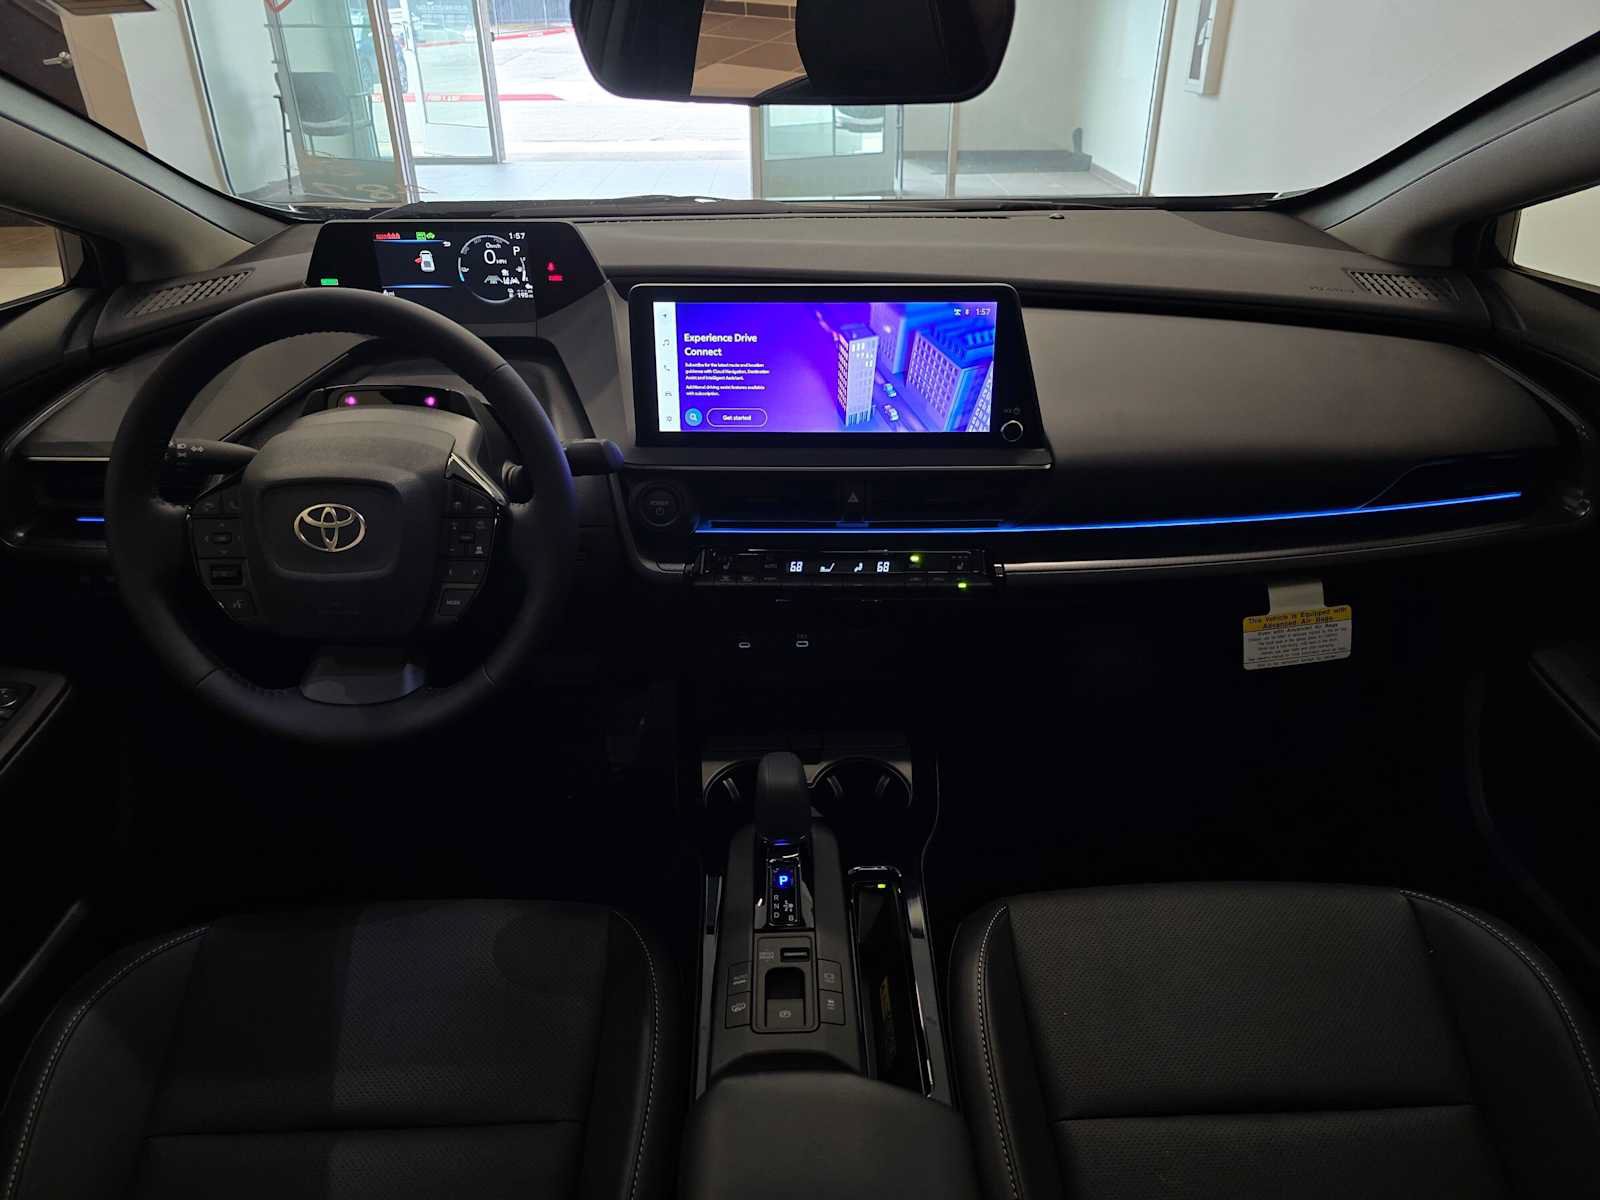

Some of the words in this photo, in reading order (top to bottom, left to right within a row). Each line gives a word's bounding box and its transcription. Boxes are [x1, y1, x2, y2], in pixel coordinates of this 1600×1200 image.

[509, 232, 526, 240] 1:57
[513, 246, 520, 256] P
[484, 249, 496, 264] 0
[976, 308, 991, 316] 1:57
[684, 332, 733, 344] Experience
[734, 333, 758, 343] Drive
[684, 347, 723, 356] Connect
[789, 560, 803, 573] 68
[876, 560, 890, 573] 68
[779, 875, 788, 886] P
[773, 894, 780, 902] R
